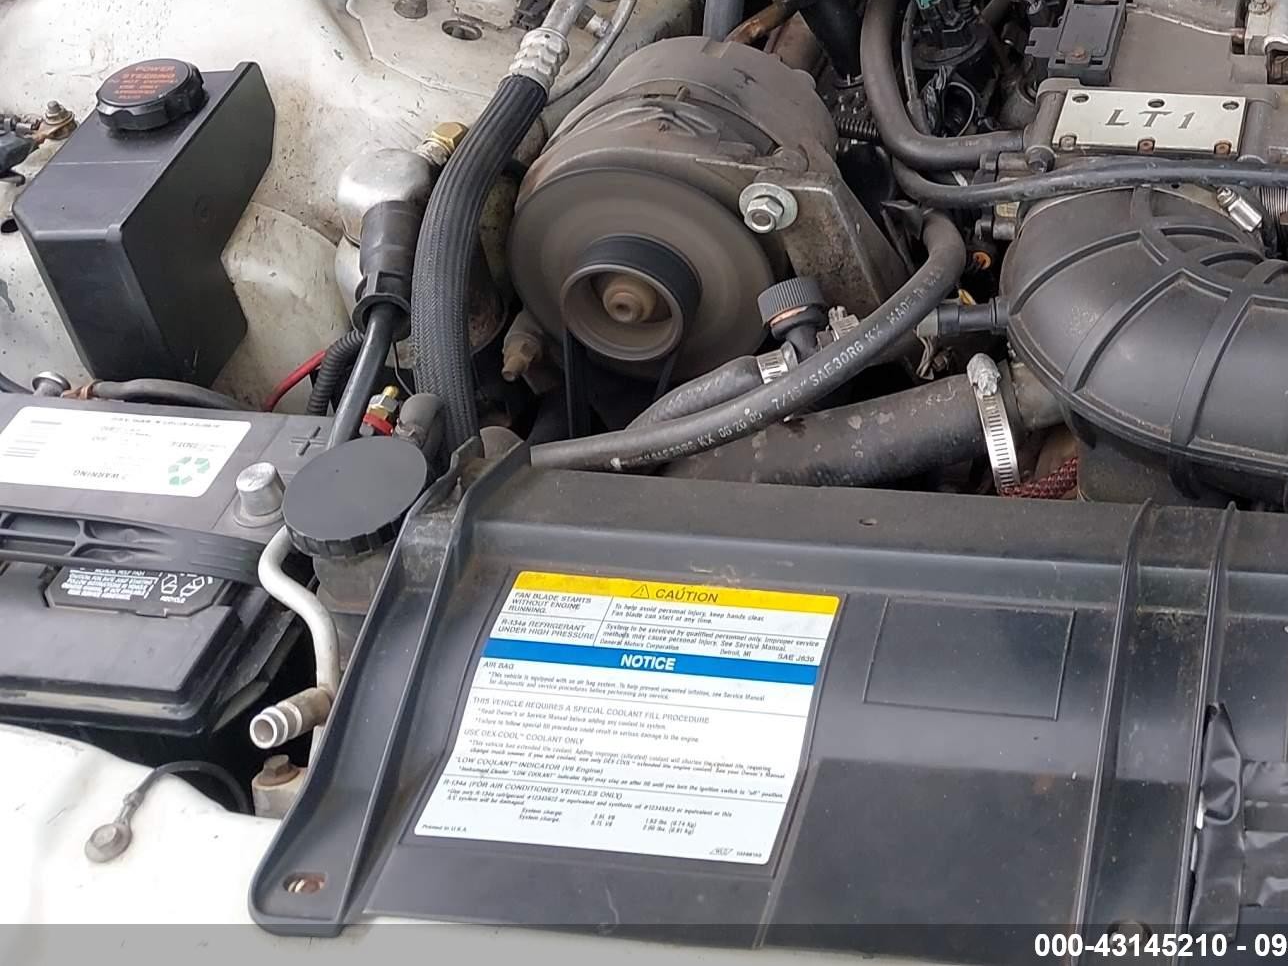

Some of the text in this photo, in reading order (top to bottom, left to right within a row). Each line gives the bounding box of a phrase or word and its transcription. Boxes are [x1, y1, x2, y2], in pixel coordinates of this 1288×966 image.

[1105, 109, 1195, 130] LT1
[562, 596, 591, 604] STARTS
[655, 589, 718, 603] CAUTION
[509, 605, 546, 613] RUNNING.
[512, 599, 580, 610] WITHOUT ENGINE
[658, 607, 684, 615] personal
[710, 611, 724, 619] keep
[498, 626, 594, 639] UNDER HIGH PRESSURE
[646, 642, 679, 651] Corporation
[621, 654, 676, 671] NOTICE
[474, 697, 490, 705] THIS
[493, 699, 523, 708] VEHICLE
[525, 702, 564, 711] REQUIRES
[573, 706, 604, 714] SPECIAL
[607, 708, 642, 718] COOLANT
[663, 713, 709, 723] PROCEDURE
[464, 728, 478, 736] USE
[526, 734, 562, 743] COOLANT
[565, 737, 584, 745] ONLY
[469, 780, 488, 788] (FOR
[490, 782, 502, 790] AIR
[505, 783, 558, 794] CONDITIONED
[560, 788, 597, 797] VEHICLES
[600, 791, 622, 799] ONLY)
